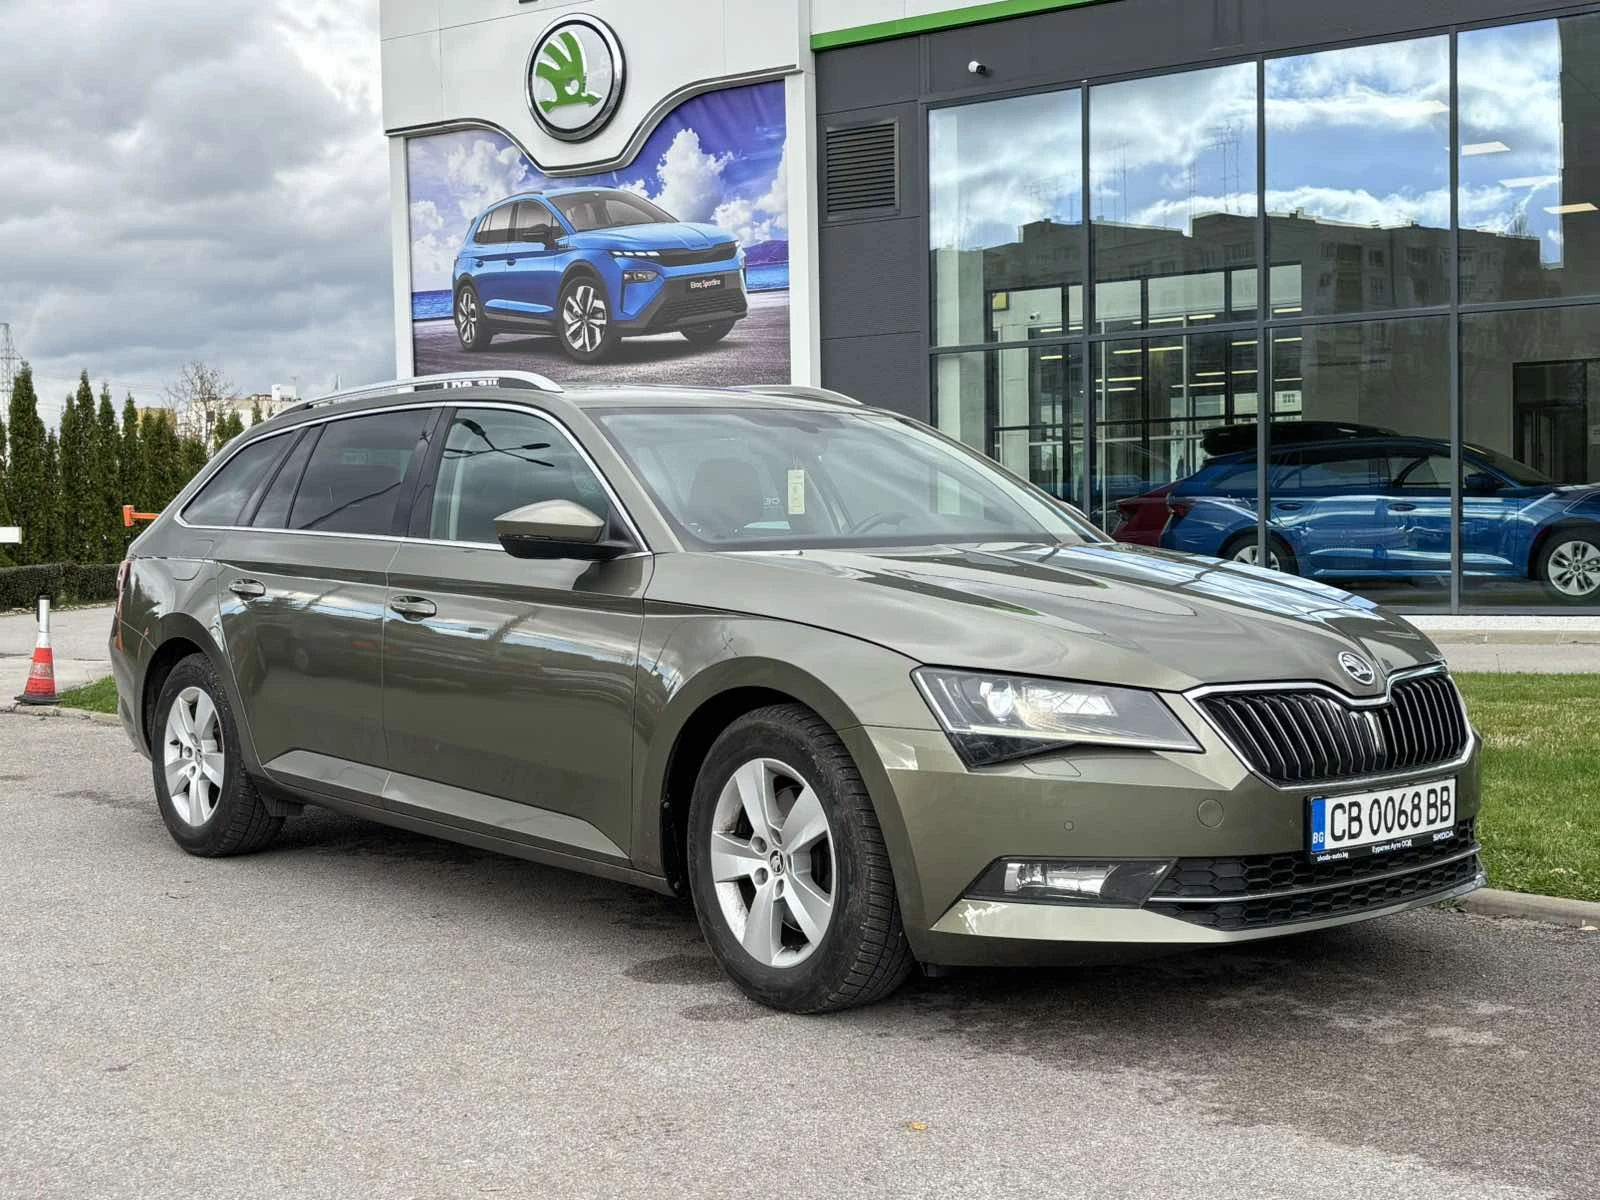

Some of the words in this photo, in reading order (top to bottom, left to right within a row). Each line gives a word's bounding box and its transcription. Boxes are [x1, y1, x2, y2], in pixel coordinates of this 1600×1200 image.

[1330, 801, 1363, 842] CB
[1368, 791, 1422, 836] 0068
[1426, 785, 1451, 826] BB
[1312, 832, 1325, 844] BG
